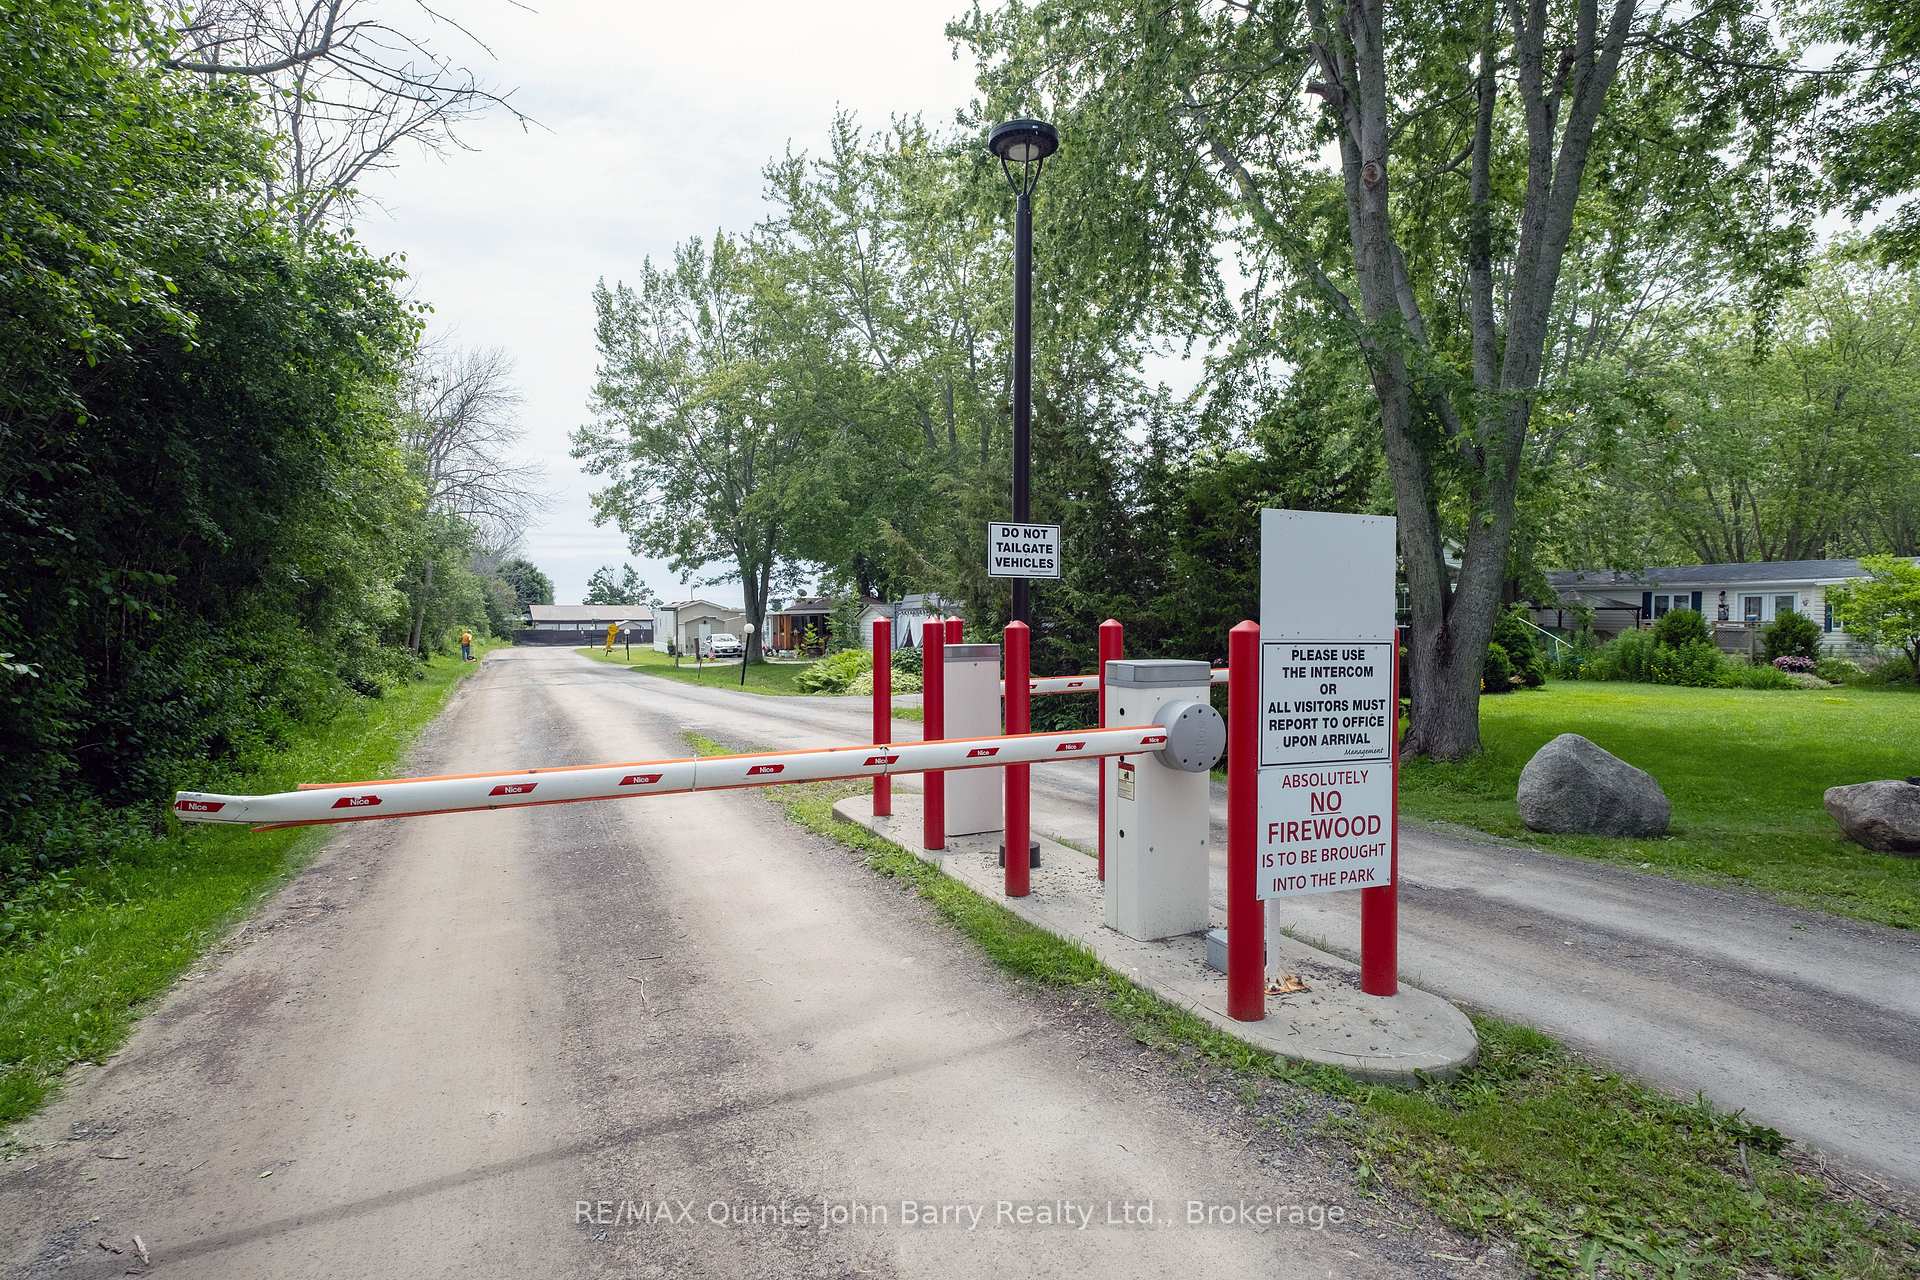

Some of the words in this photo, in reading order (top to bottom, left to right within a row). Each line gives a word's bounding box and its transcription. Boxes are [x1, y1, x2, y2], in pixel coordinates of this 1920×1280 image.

[1001, 527, 1019, 538] DO
[1023, 529, 1048, 539] NOT
[996, 542, 1053, 554] TAILGATE
[995, 557, 1054, 569] VEHICLES
[1291, 649, 1338, 661] PLEASE
[1342, 649, 1365, 661] USE
[1282, 666, 1306, 678] THE
[1310, 666, 1374, 678] INTERCOM
[1319, 683, 1337, 695] OR
[1268, 701, 1291, 714] ALL
[1294, 700, 1349, 713] VISITORS
[1352, 699, 1386, 711] MUST
[1269, 718, 1318, 731] REPORT
[1322, 717, 1338, 729] TO
[1342, 716, 1385, 728] OFFICE
[1283, 735, 1317, 748] UPON
[1321, 733, 1371, 746] ARRIVAL
[1344, 747, 1384, 757] Management
[1282, 770, 1368, 789] ABSOLUTELY
[188, 803, 208, 811] Nice
[350, 798, 370, 806] Nice
[1310, 790, 1342, 813] NO
[1268, 815, 1381, 844] FIREWOOD
[1262, 854, 1274, 868] IS
[1278, 852, 1297, 866] TO
[1301, 850, 1317, 863] BE
[1321, 843, 1386, 862] BROUGHT
[1273, 876, 1306, 892] INTO
[1310, 872, 1337, 887] THE
[1340, 868, 1375, 884] PARK
